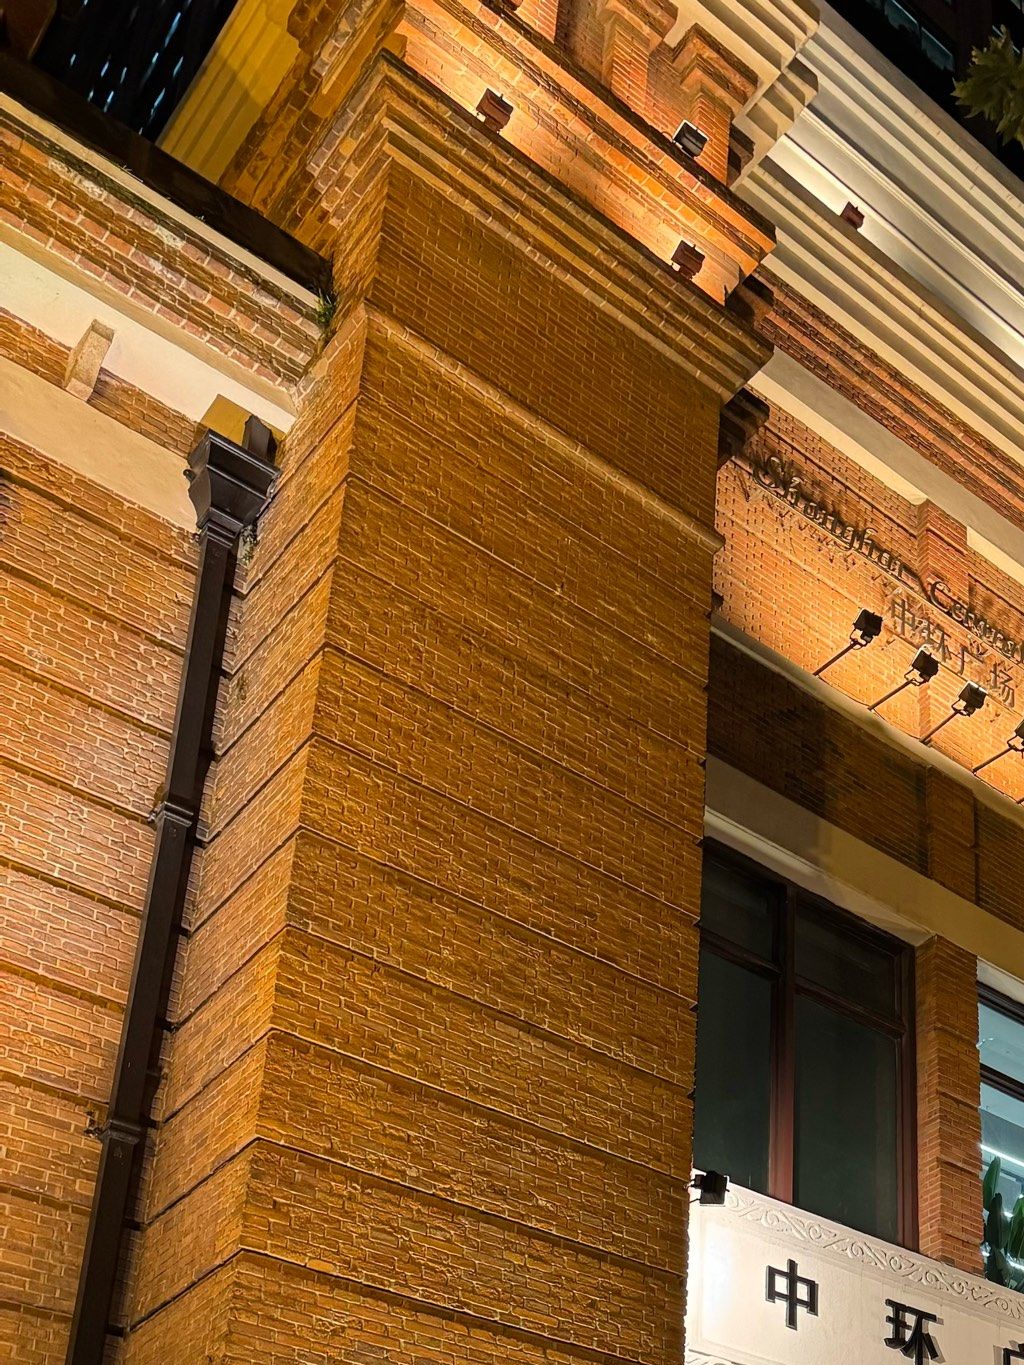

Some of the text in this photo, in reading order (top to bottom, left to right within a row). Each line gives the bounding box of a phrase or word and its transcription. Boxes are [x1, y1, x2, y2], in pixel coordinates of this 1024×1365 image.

[752, 456, 903, 578] Shanghai
[891, 599, 1015, 708] 中环广场
